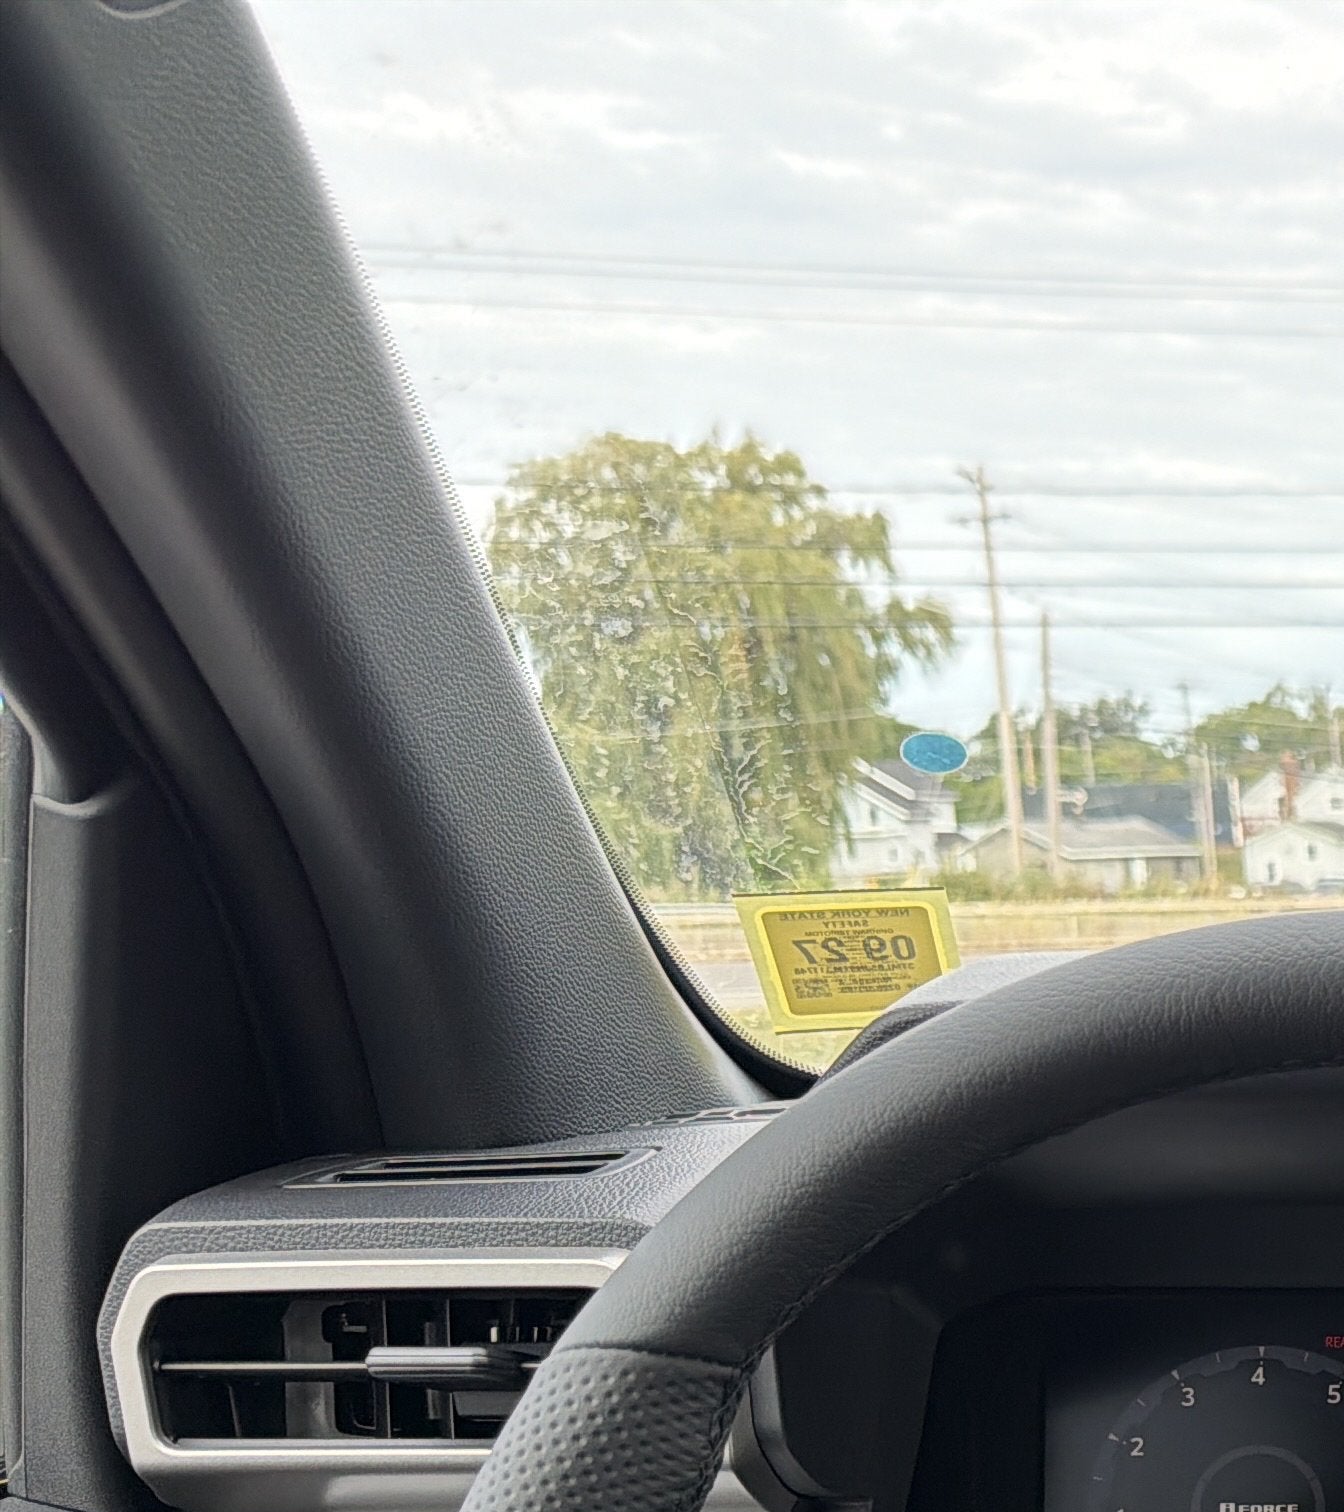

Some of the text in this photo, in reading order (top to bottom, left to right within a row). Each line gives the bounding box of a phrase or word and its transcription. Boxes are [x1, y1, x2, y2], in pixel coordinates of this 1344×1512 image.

[1251, 1367, 1265, 1385] 4
[1181, 1387, 1195, 1407] 3
[1327, 1384, 1341, 1403] 5
[1130, 1438, 1144, 1456] 2
